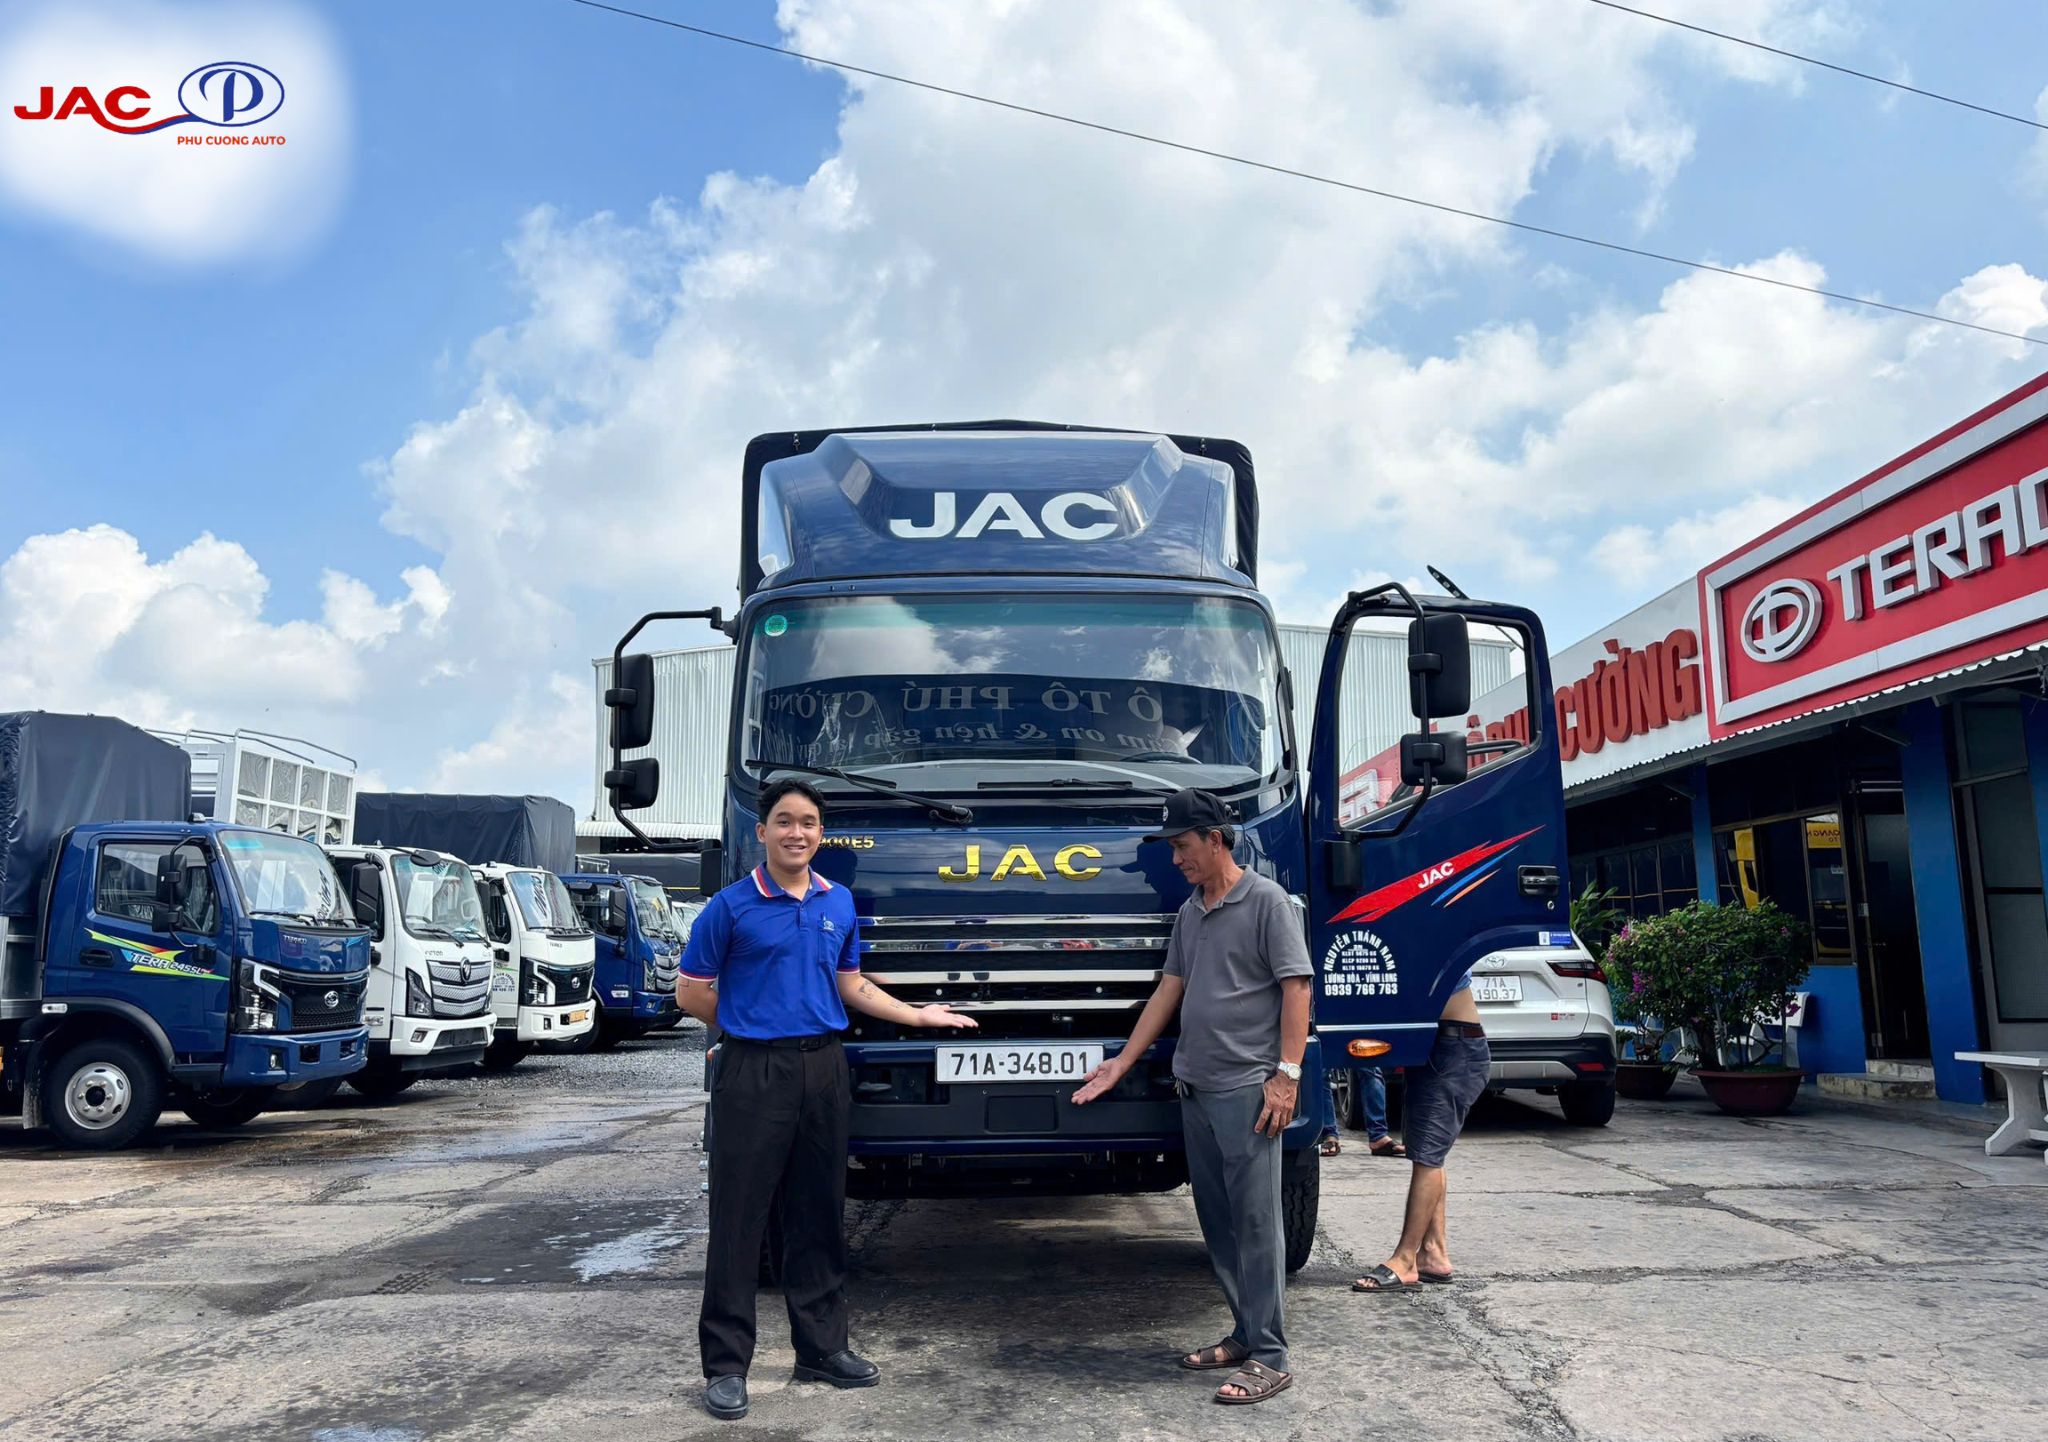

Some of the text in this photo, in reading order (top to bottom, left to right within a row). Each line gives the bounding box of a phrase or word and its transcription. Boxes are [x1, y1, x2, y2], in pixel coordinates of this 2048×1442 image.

[890, 492, 1119, 540] JAC
[1555, 629, 1702, 761] CƯỜNG
[938, 844, 1103, 882] JAC
[1418, 862, 1454, 888] JAC
[132, 952, 170, 970] TERA
[1380, 945, 1396, 970] NAM
[1325, 983, 1398, 996] 0939 766 763
[1477, 989, 1516, 999] 190.37
[1485, 977, 1506, 988] 71A
[951, 1052, 1087, 1075] 71A-348.01
